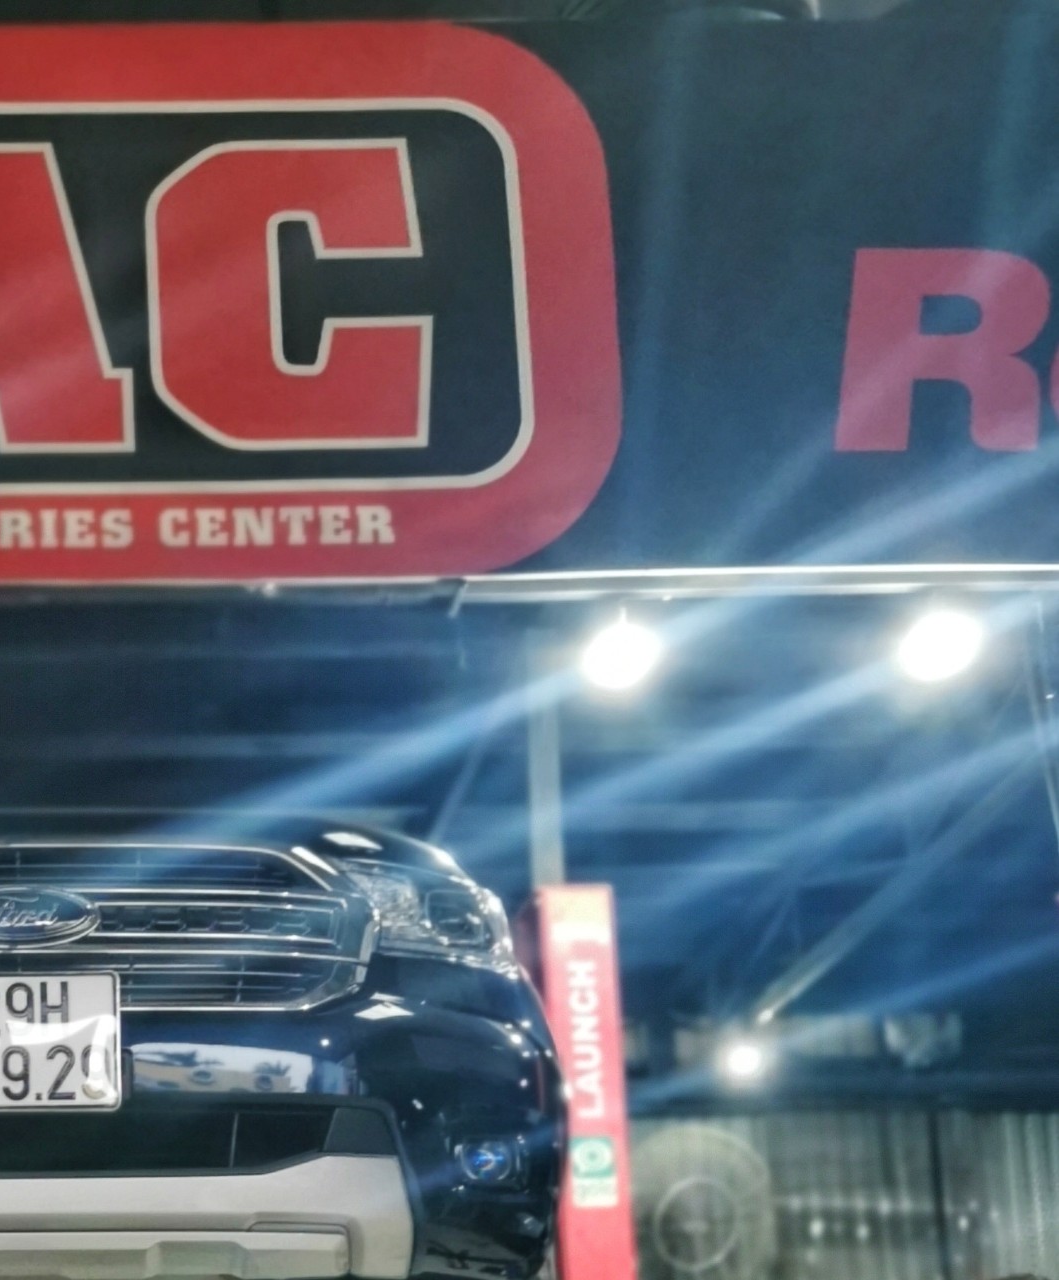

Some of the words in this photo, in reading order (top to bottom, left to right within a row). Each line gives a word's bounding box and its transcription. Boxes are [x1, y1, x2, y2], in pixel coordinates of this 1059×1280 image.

[835, 247, 1059, 452] R
[158, 504, 397, 548] CENTER
[567, 960, 606, 1118] LAUNCH
